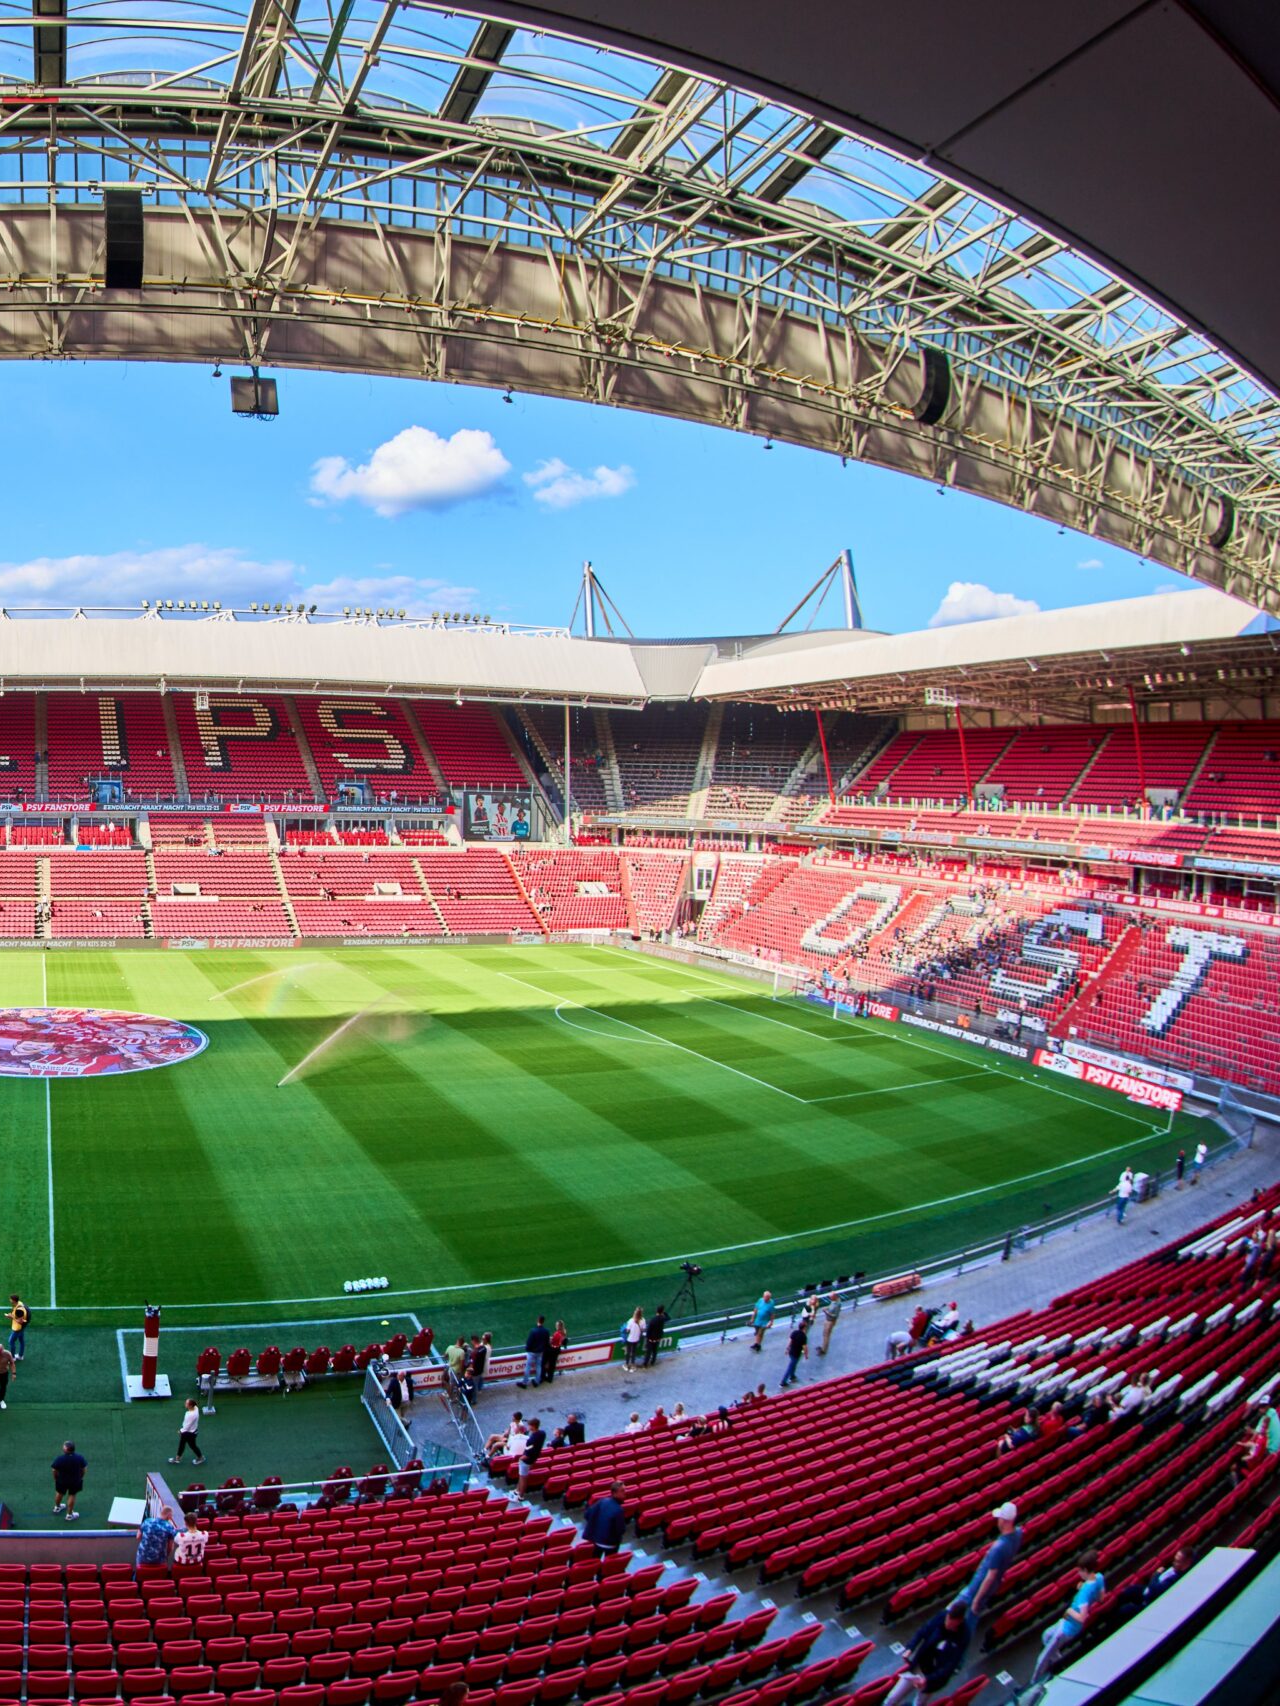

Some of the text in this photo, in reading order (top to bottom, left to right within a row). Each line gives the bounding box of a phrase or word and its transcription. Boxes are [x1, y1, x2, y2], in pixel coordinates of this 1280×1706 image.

[1112, 850, 1129, 860] PSV
[1130, 852, 1176, 865] FANSTORE
[214, 939, 294, 948] PSV FANSTORE
[901, 1013, 939, 1031] EENDRACHT
[939, 1024, 962, 1038] MAAKT
[962, 1031, 988, 1045] MACHT
[989, 1038, 1000, 1050] PSV
[1055, 1058, 1068, 1069] PSV
[1086, 1066, 1182, 1109] PSV FANSTORE
[186, 1544, 202, 1558] 11
